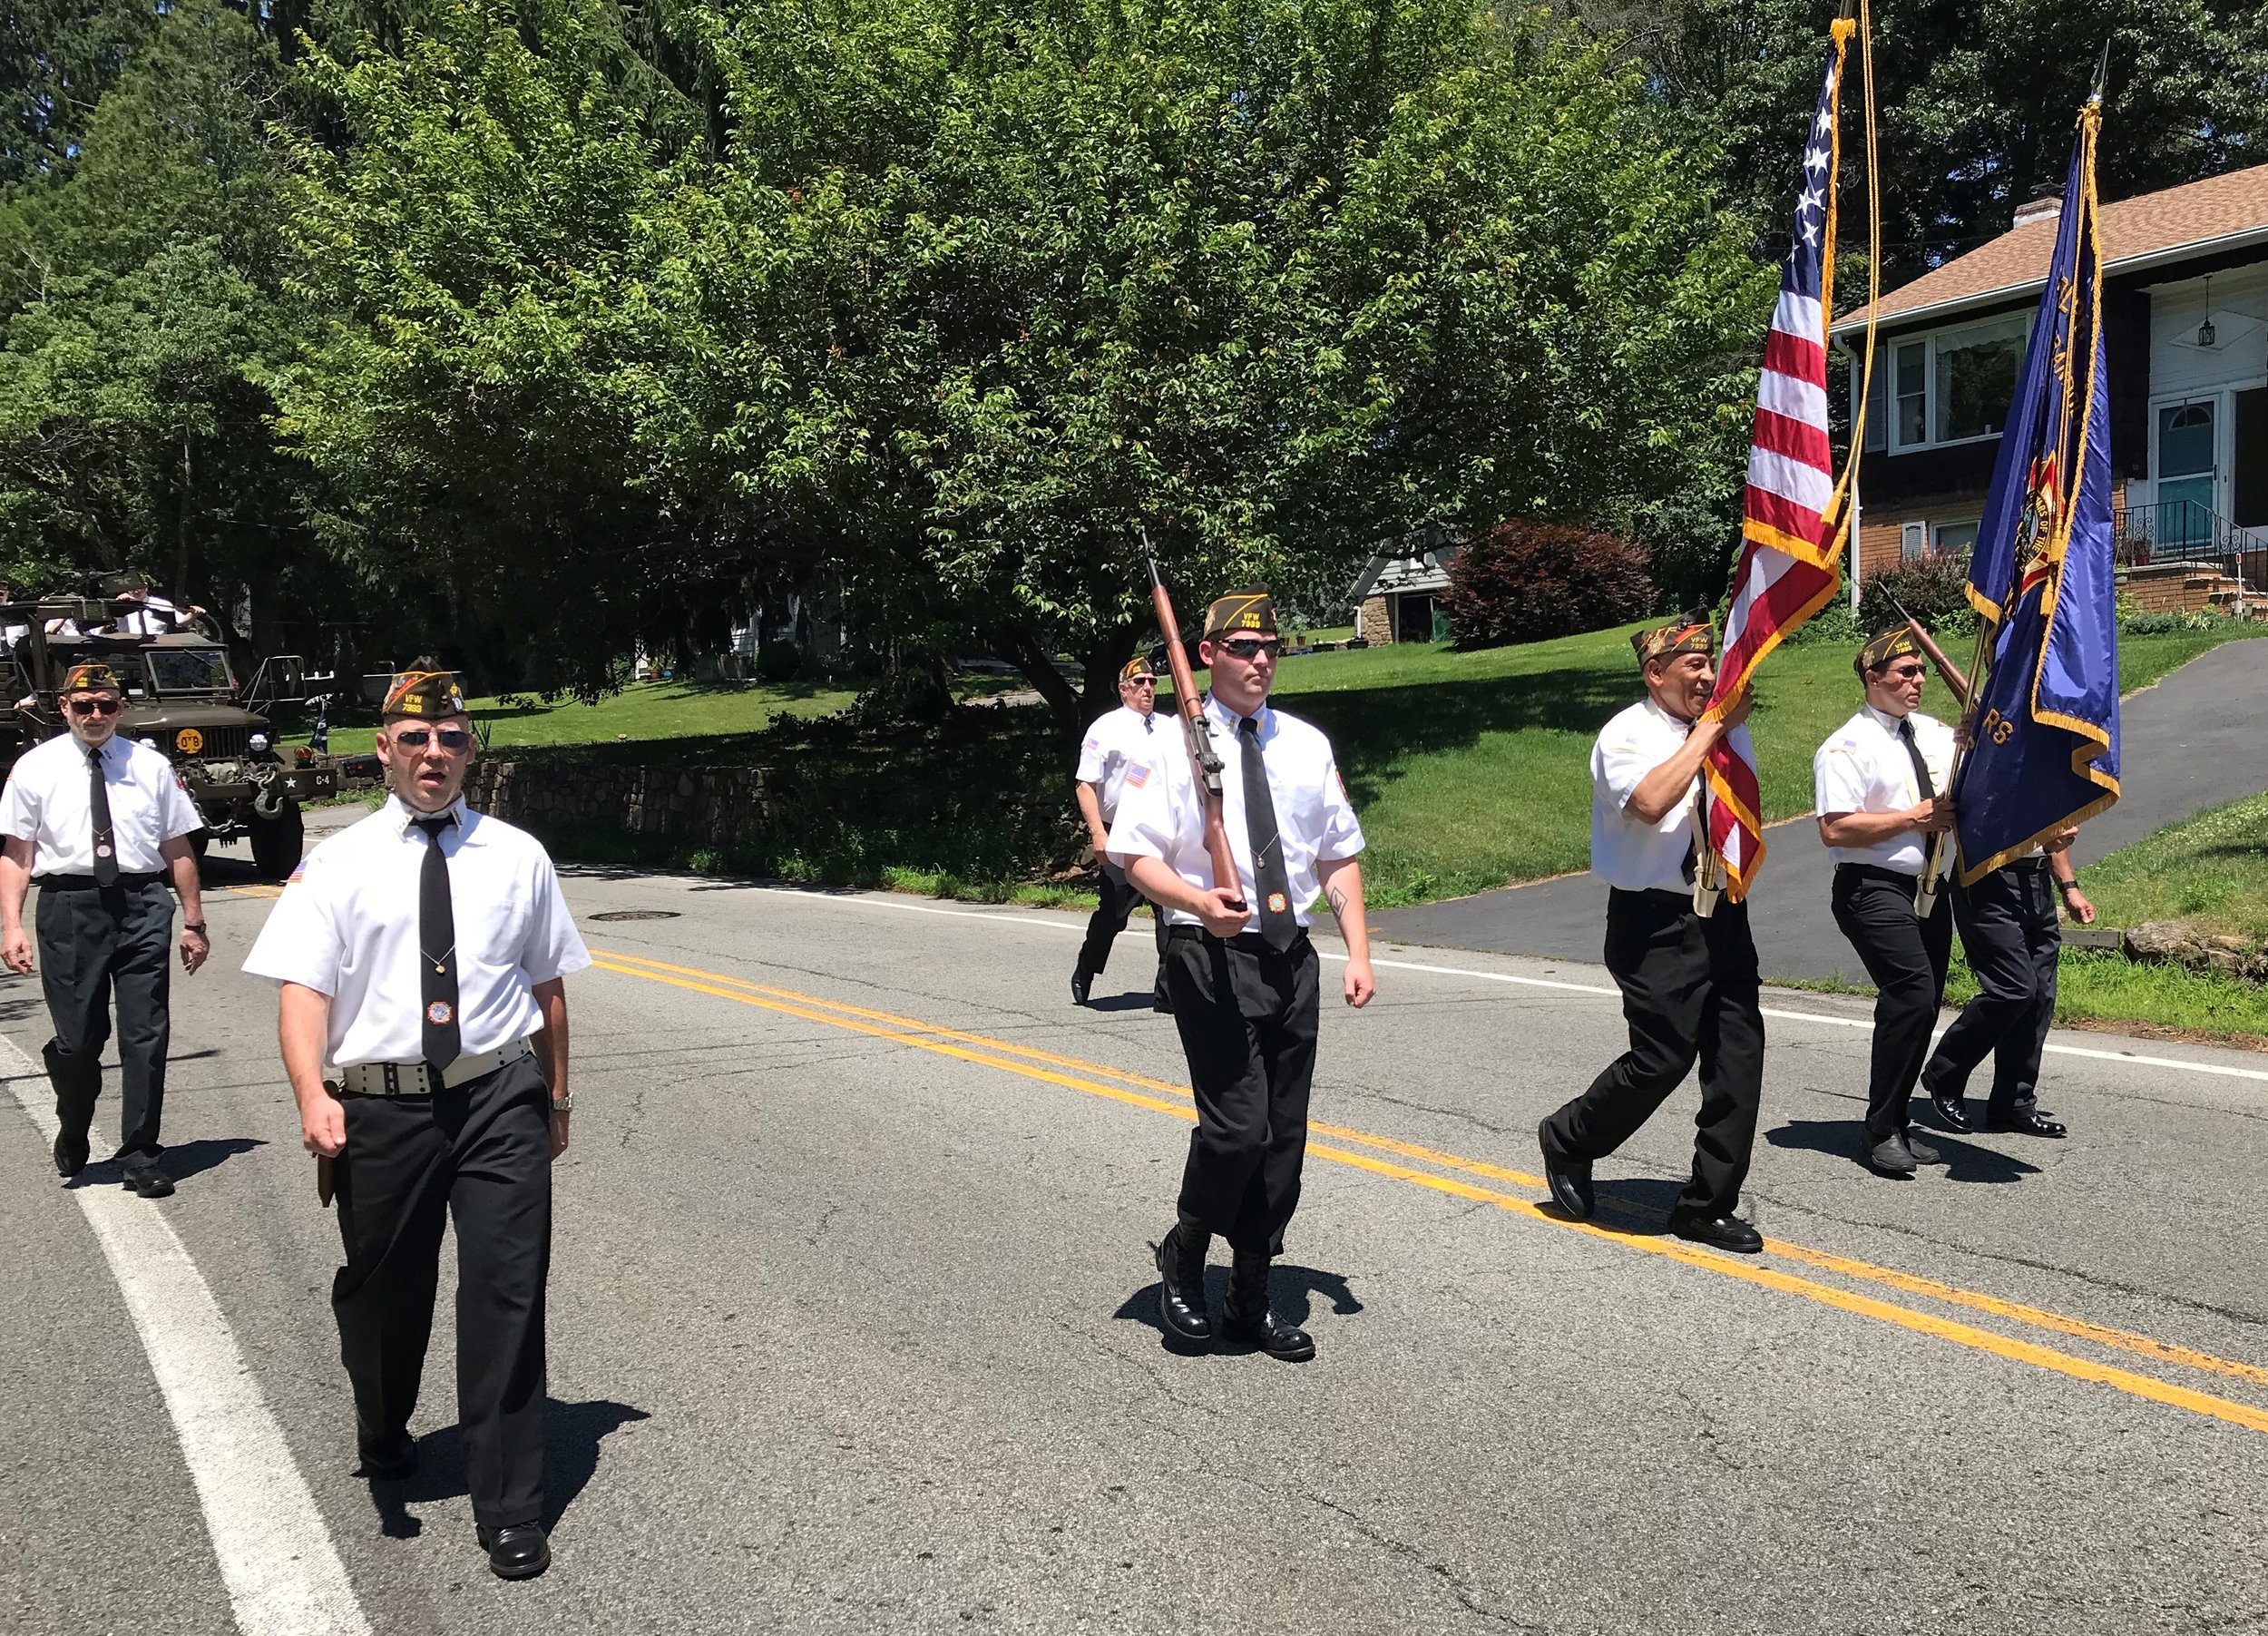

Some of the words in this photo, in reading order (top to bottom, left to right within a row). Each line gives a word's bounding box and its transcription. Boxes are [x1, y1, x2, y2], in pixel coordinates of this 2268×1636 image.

[2039, 520, 2048, 534] OF
[2032, 535, 2046, 553] THE
[1894, 640, 1911, 649] VFW
[405, 694, 423, 703] VFW
[316, 775, 330, 786] C-4
